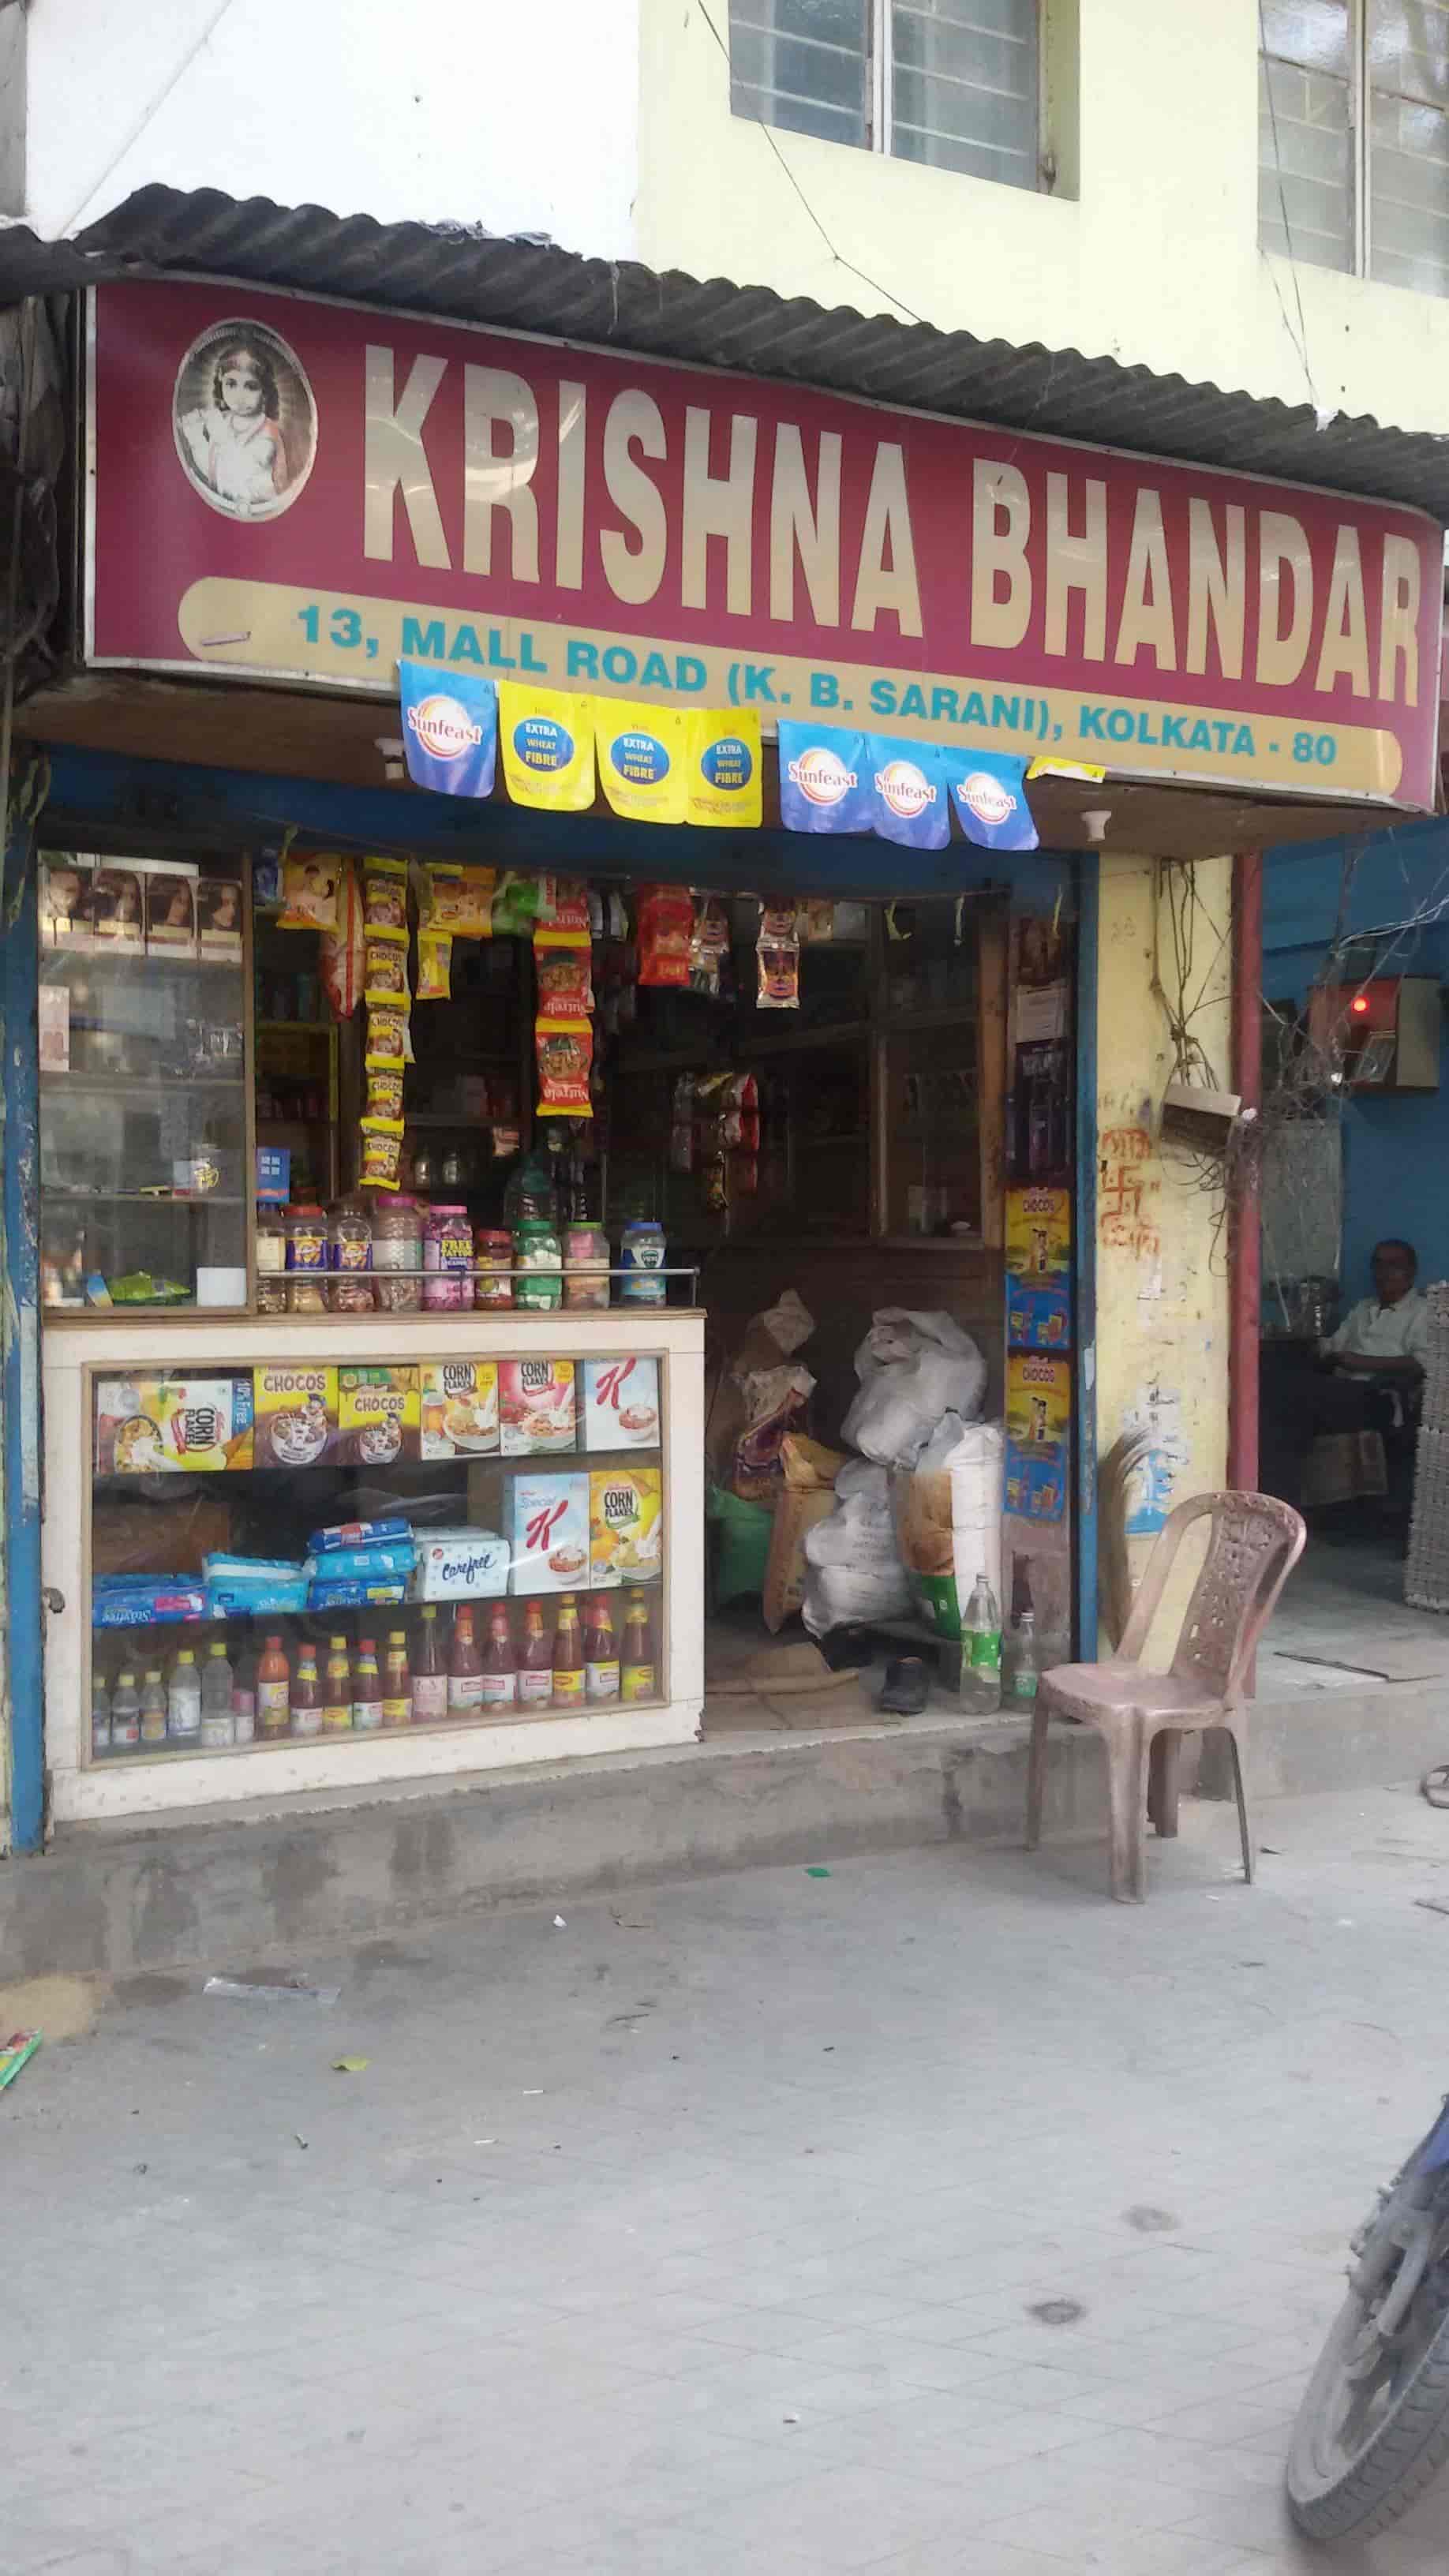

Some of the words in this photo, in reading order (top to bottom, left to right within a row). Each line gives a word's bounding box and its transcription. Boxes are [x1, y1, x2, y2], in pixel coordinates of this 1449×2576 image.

[363, 343, 923, 638] KRISHNA
[970, 456, 1421, 708] BHANDAR
[298, 605, 379, 658] 13,
[401, 616, 548, 673] MALL
[567, 638, 708, 693] ROAD
[728, 663, 792, 706] (K.
[810, 672, 853, 710] B.
[870, 679, 1062, 741] SARANI),
[1078, 705, 1256, 756] KOLKATA
[1292, 732, 1337, 766] 80
[409, 707, 481, 744] Sunfeast
[524, 722, 558, 738] EXTRA
[526, 737, 556, 751] WHEAT
[622, 737, 655, 752] EXTRA
[715, 743, 743, 755] EXTRA
[525, 751, 558, 766] FIBRE
[623, 764, 655, 780] FIBRE
[714, 772, 743, 784] FIBRE
[788, 762, 857, 788] Sunfeast
[875, 774, 936, 802] Sunfeast
[957, 785, 1016, 811] Sunfeast
[442, 1363, 472, 1381] CORN
[521, 1360, 549, 1377] CORN
[263, 1373, 327, 1392] CHOCOS
[354, 1397, 406, 1412] CHOCOS
[194, 1407, 215, 1445] CORN
[604, 1490, 634, 1509] CORN
[605, 1507, 635, 1518] FLAKES
